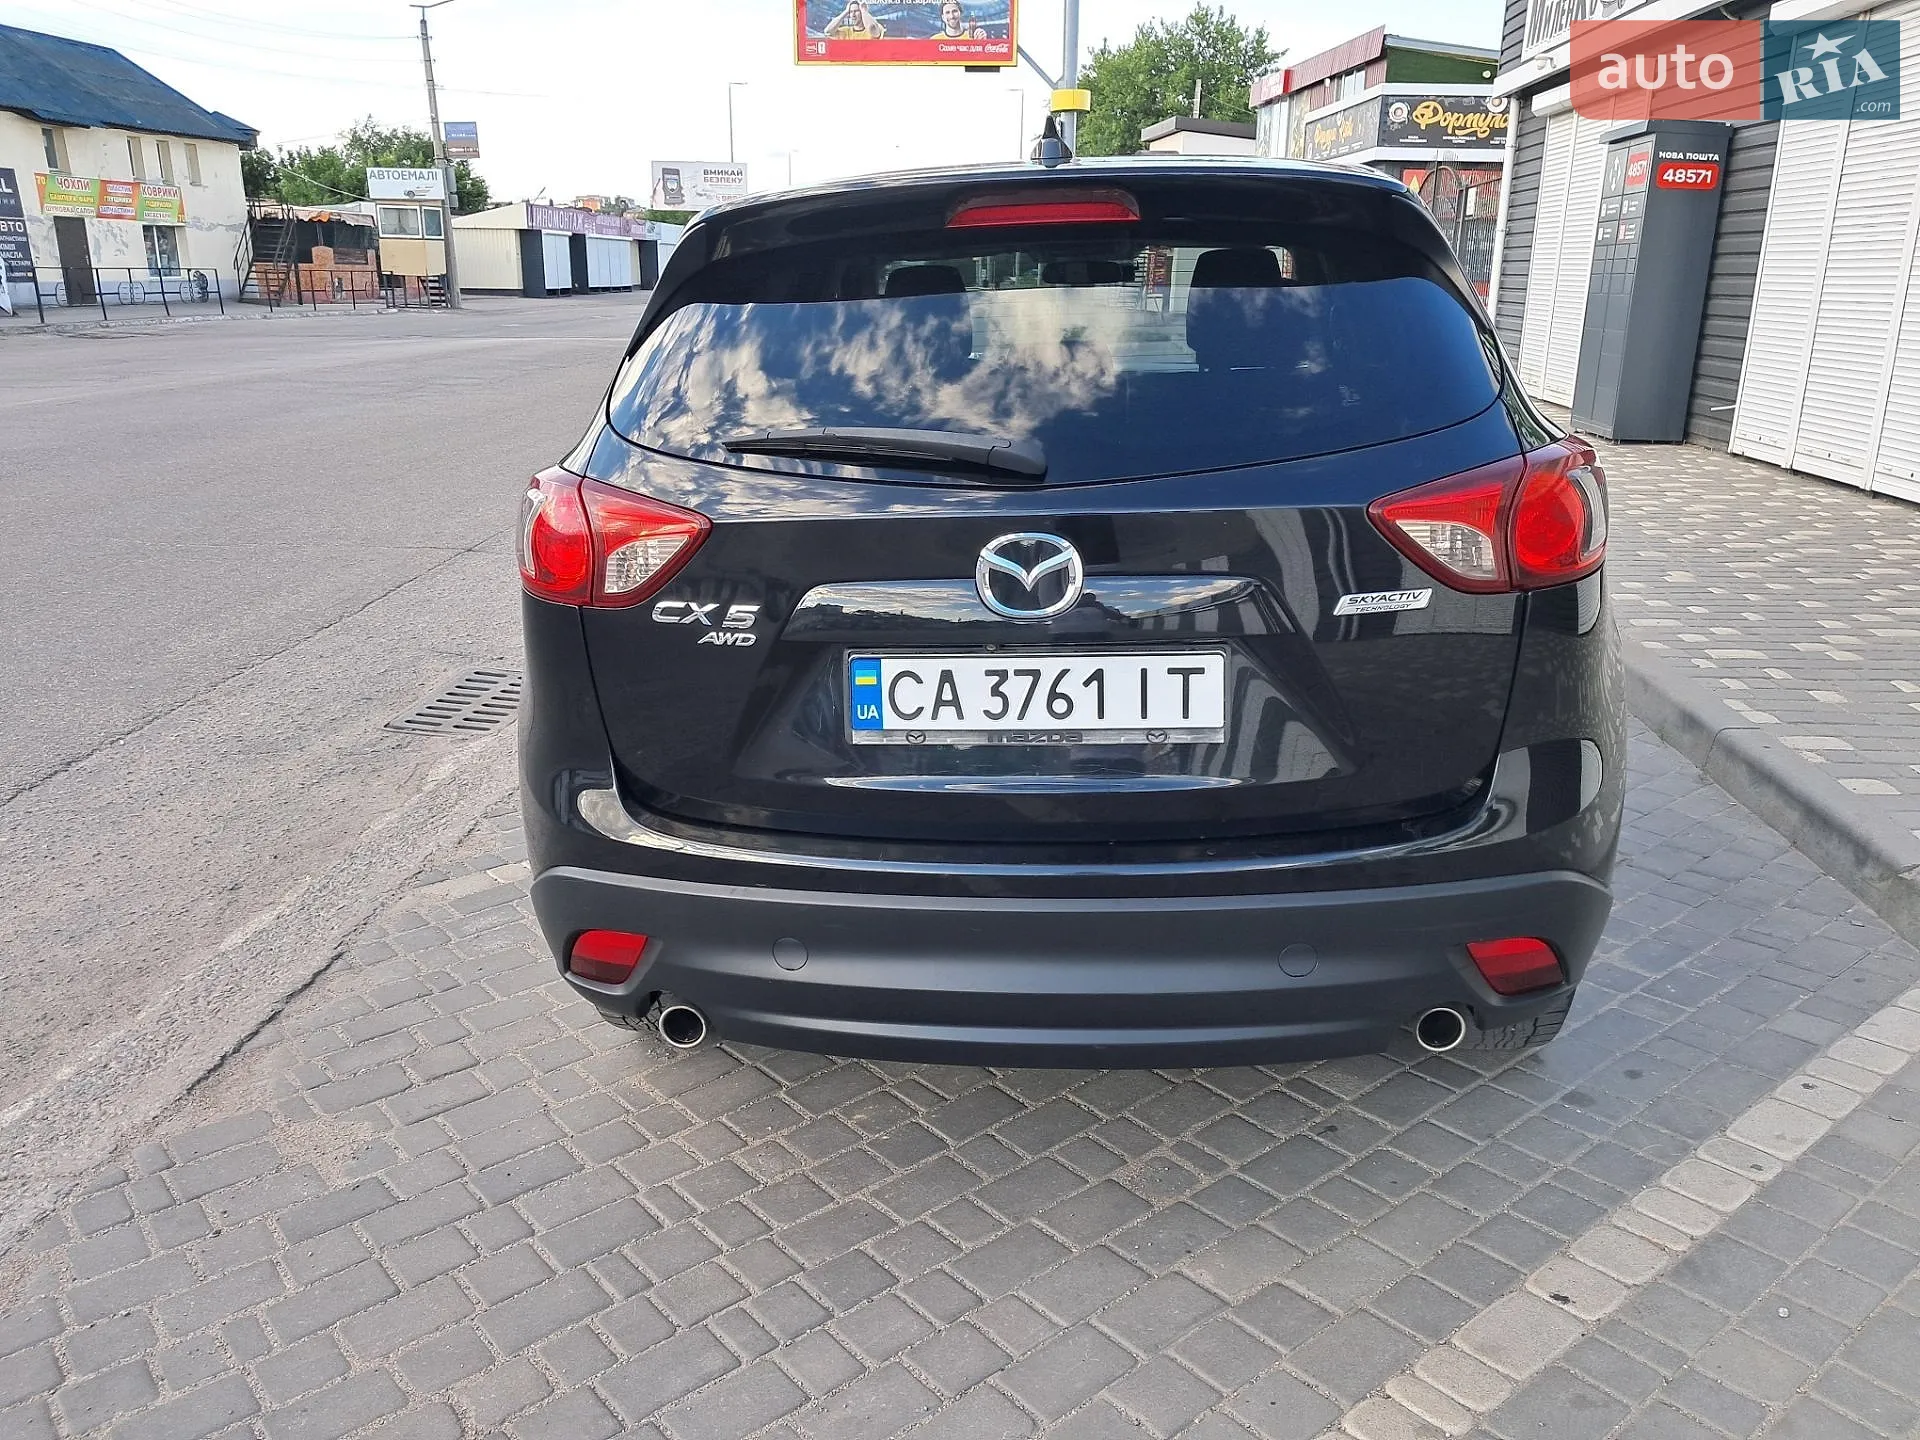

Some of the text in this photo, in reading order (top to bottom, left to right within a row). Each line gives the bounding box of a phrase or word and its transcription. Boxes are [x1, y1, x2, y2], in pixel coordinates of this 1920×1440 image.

[1659, 151, 1719, 161] НОВА ПОШТА
[369, 169, 438, 181] АВТОЕМАЛІ
[703, 167, 743, 177] ВМИКАЙ
[1627, 160, 1649, 177] 48571
[703, 176, 743, 184] БЕЗПЕКУ
[1662, 168, 1712, 184] 48571
[57, 177, 91, 190] ЧОХЛИ
[141, 185, 179, 198] КОВРИКИ
[528, 205, 584, 231] ШИНОМОНТАЖ
[1347, 591, 1423, 605] SKYACTIV
[652, 600, 761, 629] CX 5
[1355, 603, 1412, 613] TECHNOLOGY
[697, 631, 757, 647] AWD
[888, 667, 1206, 721] CA 3761 IT
[857, 705, 879, 720] UA
